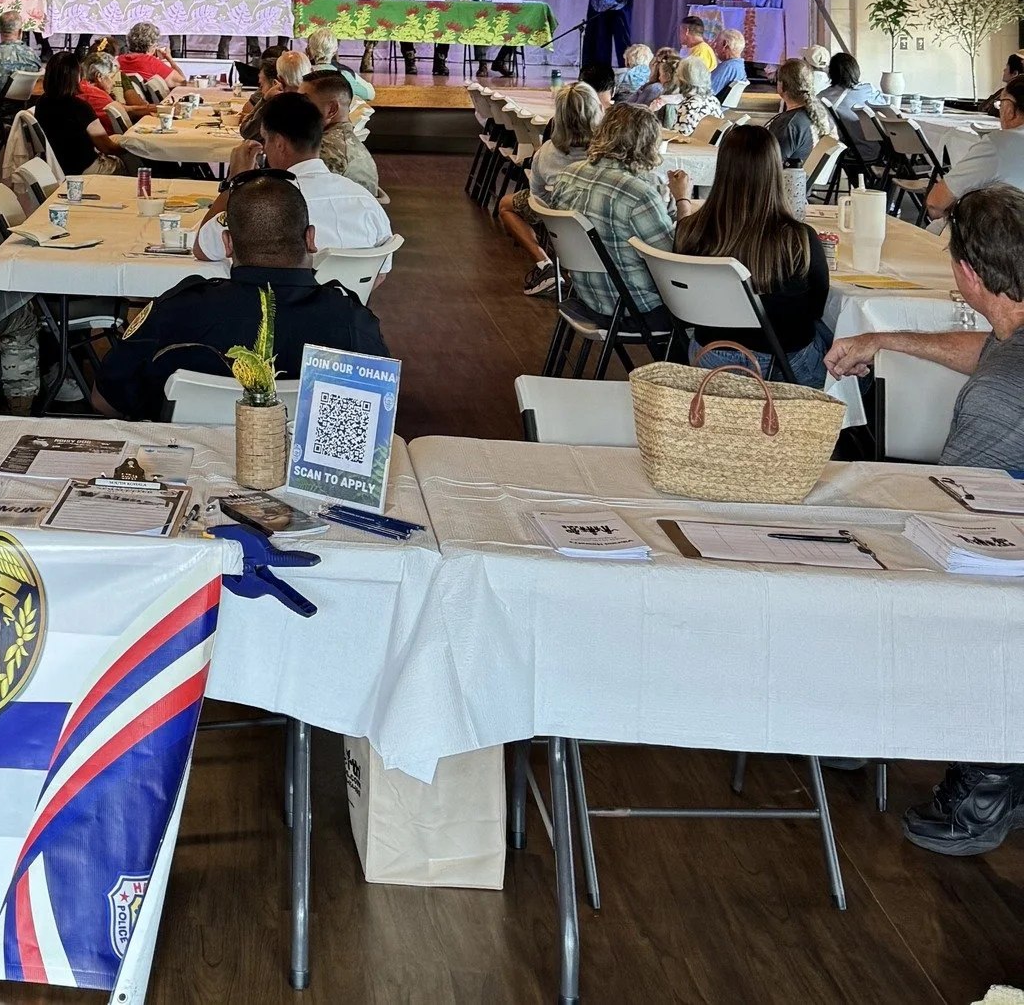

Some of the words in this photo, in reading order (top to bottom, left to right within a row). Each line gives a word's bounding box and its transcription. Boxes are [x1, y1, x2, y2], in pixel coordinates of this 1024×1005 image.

[306, 357, 330, 370] JOIN
[332, 361, 353, 374] OUR
[294, 465, 322, 481] SCAN
[325, 472, 339, 485] TO
[340, 477, 376, 494] APPLY
[117, 905, 129, 944] POLICE
